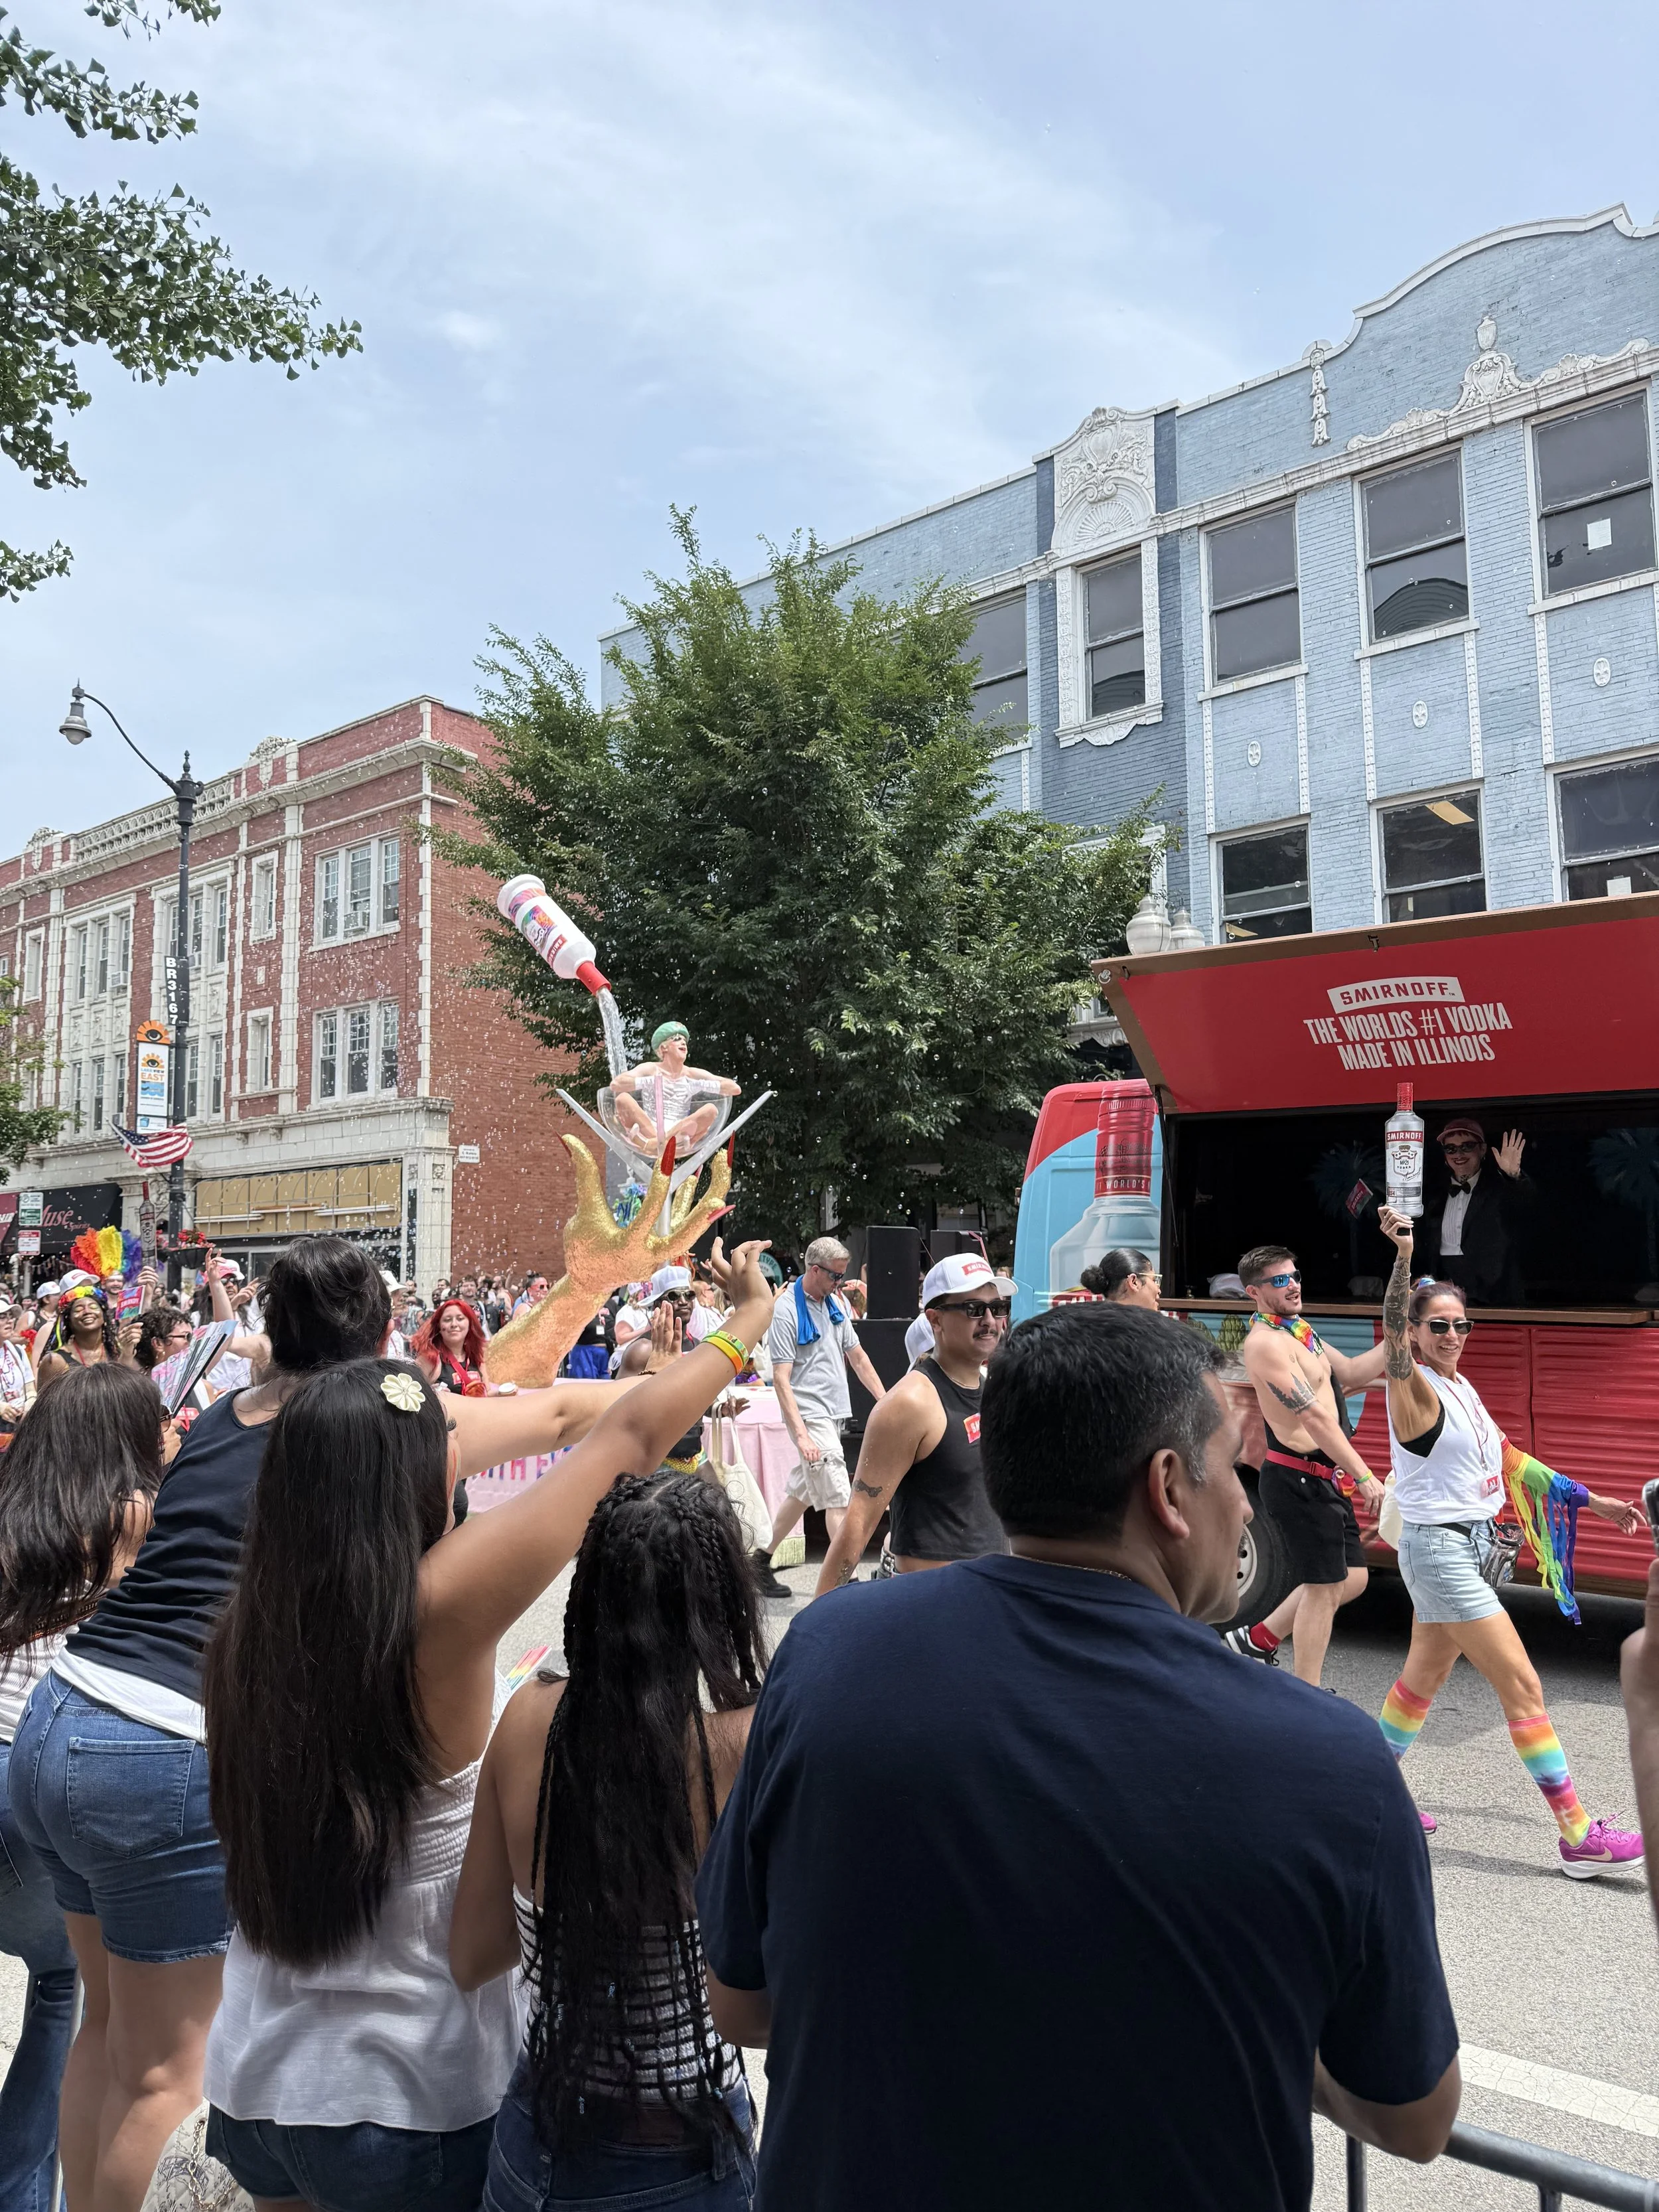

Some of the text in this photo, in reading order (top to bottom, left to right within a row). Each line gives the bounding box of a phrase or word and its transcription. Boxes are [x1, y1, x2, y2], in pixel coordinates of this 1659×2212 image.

[165, 957, 178, 1025] BR3167
[1340, 982, 1449, 1005] SMIRNOFF
[1303, 1002, 1513, 1044] THE WORLDS #1 VODKA
[1337, 1033, 1496, 1070] MADE IN ILLINOIS
[141, 1072, 165, 1081] EAST
[1387, 1132, 1421, 1141] SMIRNOFF
[1106, 1179, 1145, 1189] WORLD'S
